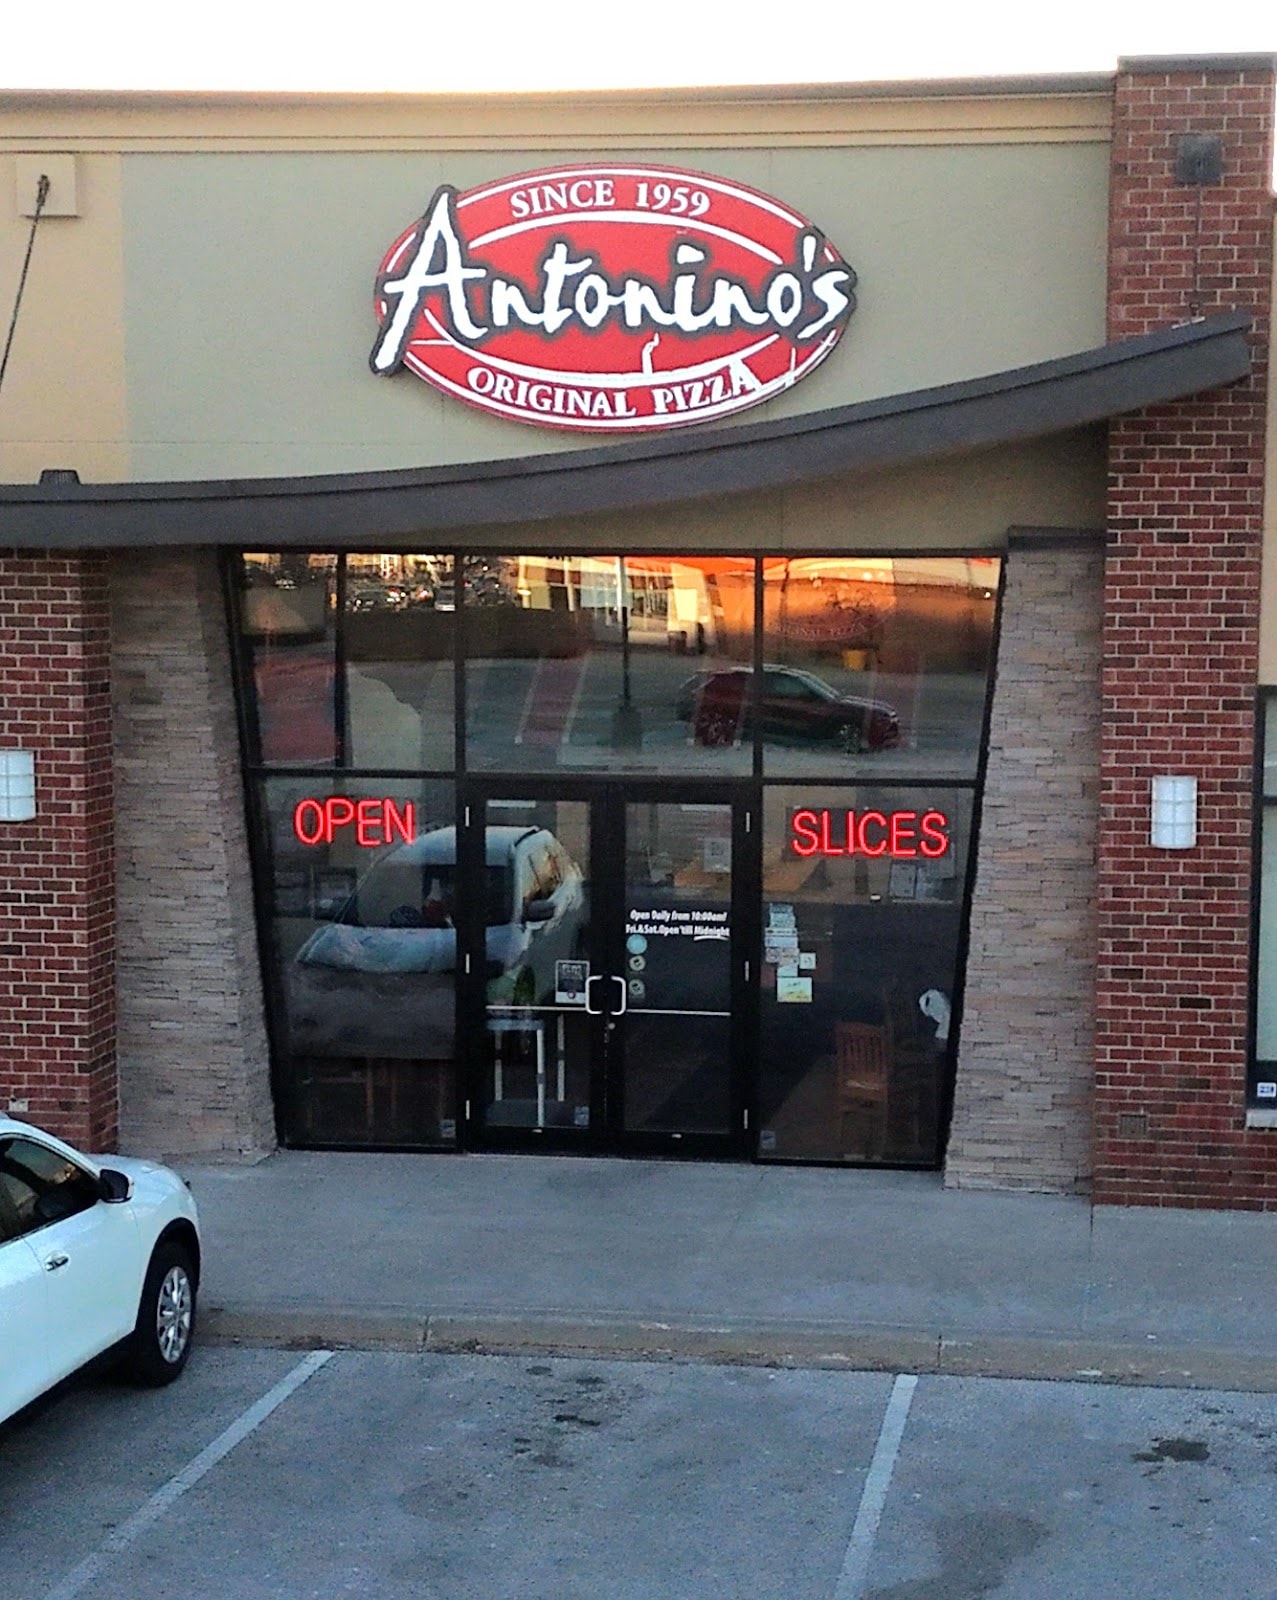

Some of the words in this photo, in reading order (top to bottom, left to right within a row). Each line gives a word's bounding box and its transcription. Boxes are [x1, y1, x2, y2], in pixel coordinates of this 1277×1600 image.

[511, 180, 615, 219] SINCE
[635, 181, 710, 217] 1959
[374, 192, 850, 370] Antonino's
[467, 366, 637, 417] ORIGINAL
[652, 358, 765, 412] PIZZA
[293, 796, 416, 846] OPEN
[787, 808, 948, 858] SLICES
[630, 909, 650, 922] Open
[651, 910, 671, 922] Daily
[671, 910, 690, 921] from
[694, 925, 730, 938] Midnight
